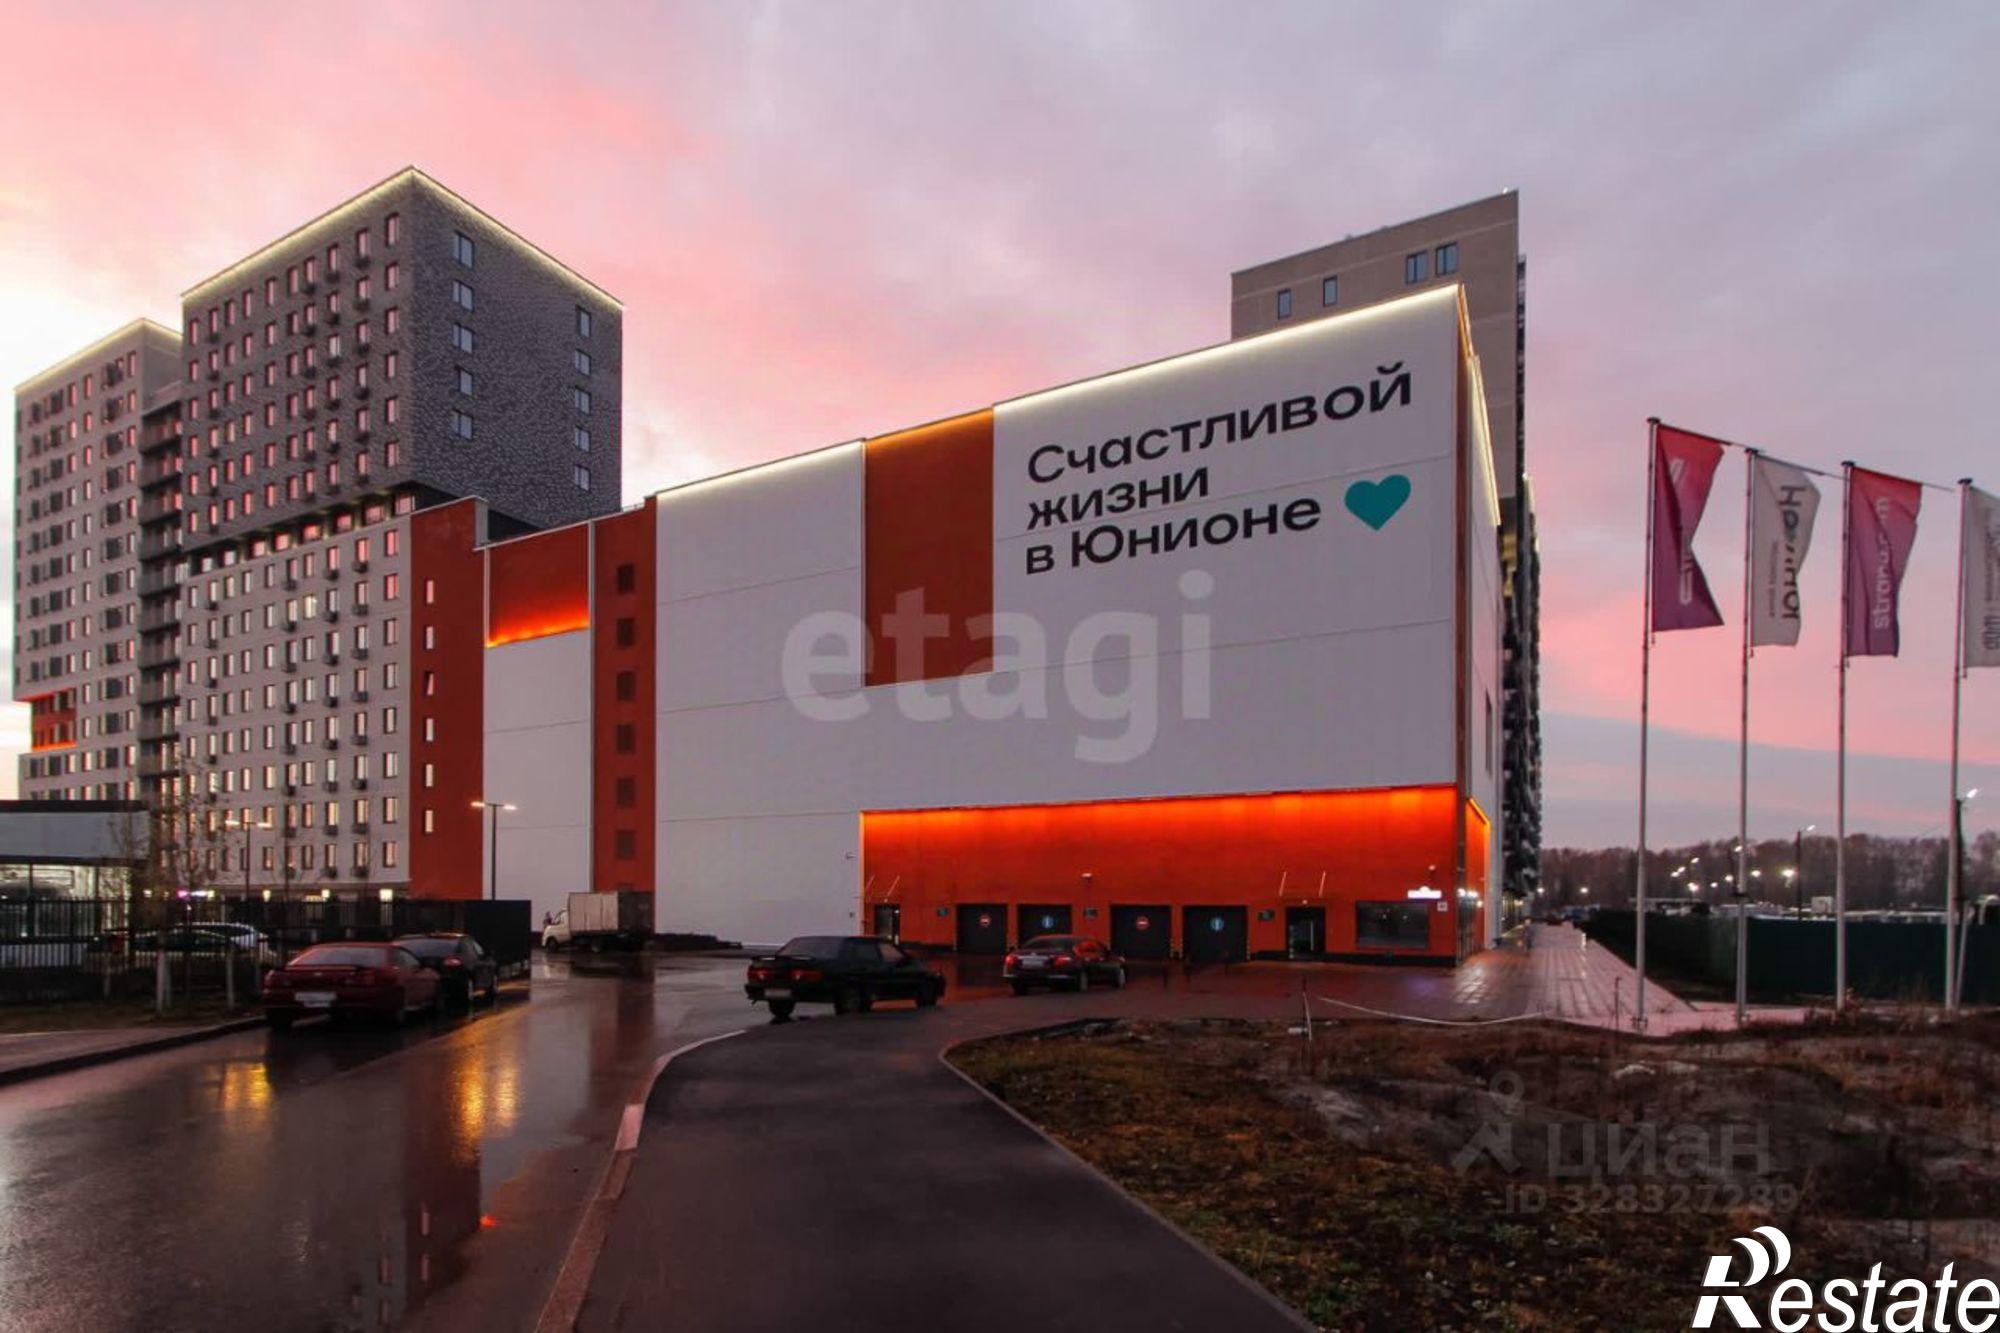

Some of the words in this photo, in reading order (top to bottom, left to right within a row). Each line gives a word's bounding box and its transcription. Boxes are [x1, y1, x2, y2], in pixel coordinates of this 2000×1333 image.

[1028, 361, 1412, 483] Счастливой
[1026, 544, 1055, 574] в
[1071, 498, 1321, 568] Юнионе
[1027, 467, 1209, 530] жизни
[1873, 498, 1890, 629] strana.cm
